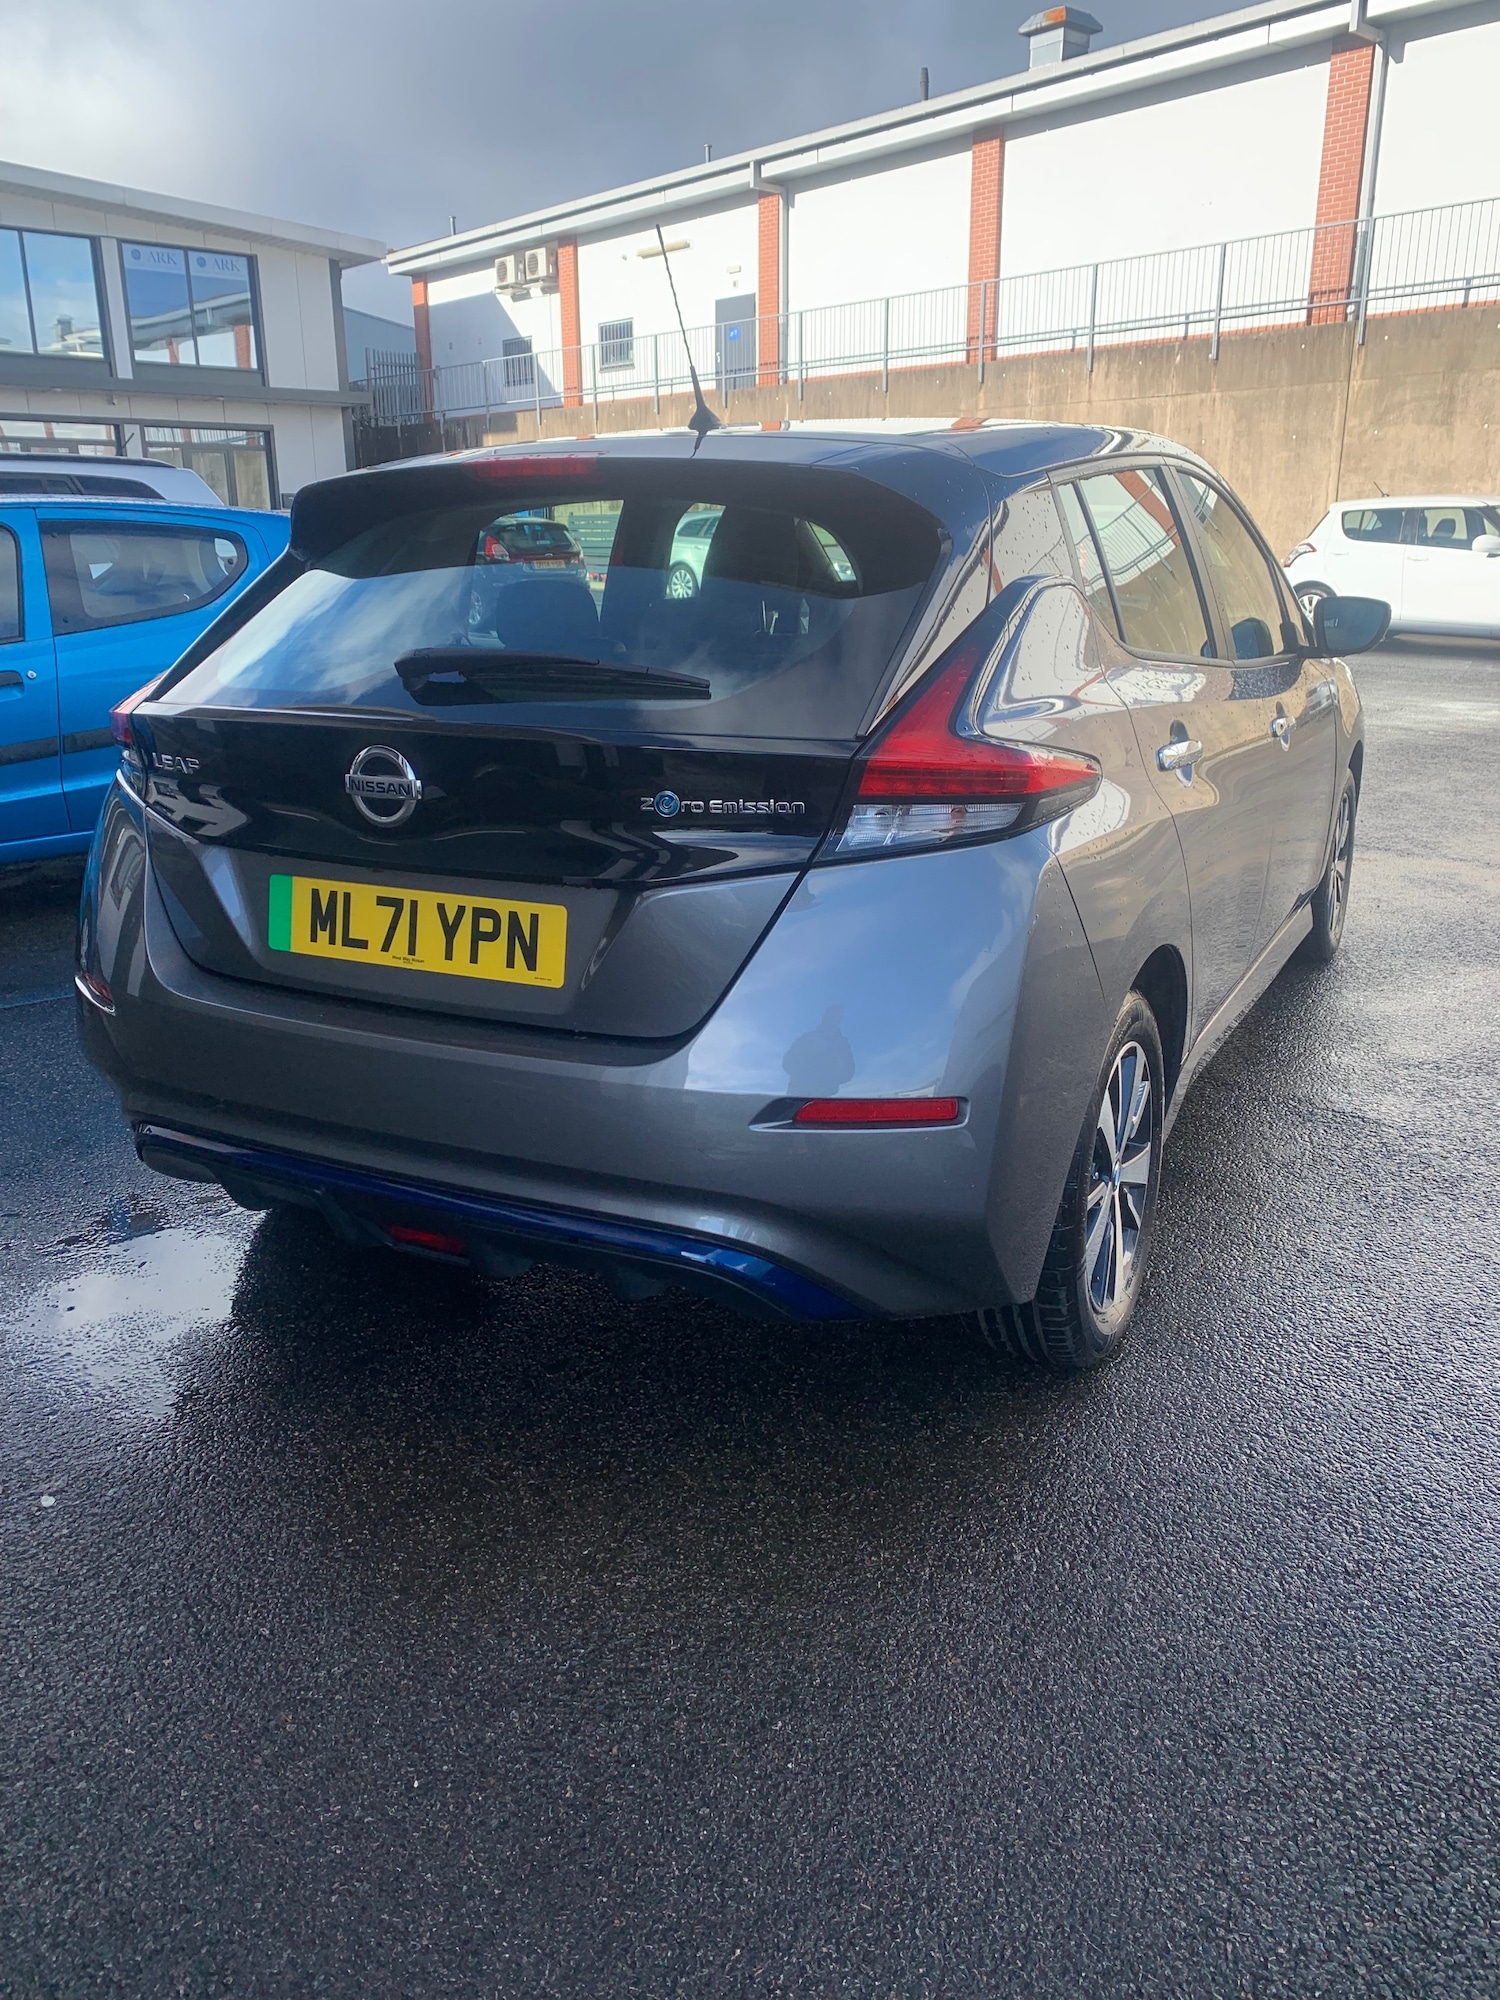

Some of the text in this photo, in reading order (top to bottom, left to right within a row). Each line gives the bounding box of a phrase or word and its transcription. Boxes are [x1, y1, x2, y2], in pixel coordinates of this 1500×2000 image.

[147, 250, 177, 265] ARK
[212, 257, 241, 272] ARK
[152, 752, 200, 774] LEAF
[350, 778, 411, 797] NISSAN
[310, 888, 539, 972] ML71 YPN
